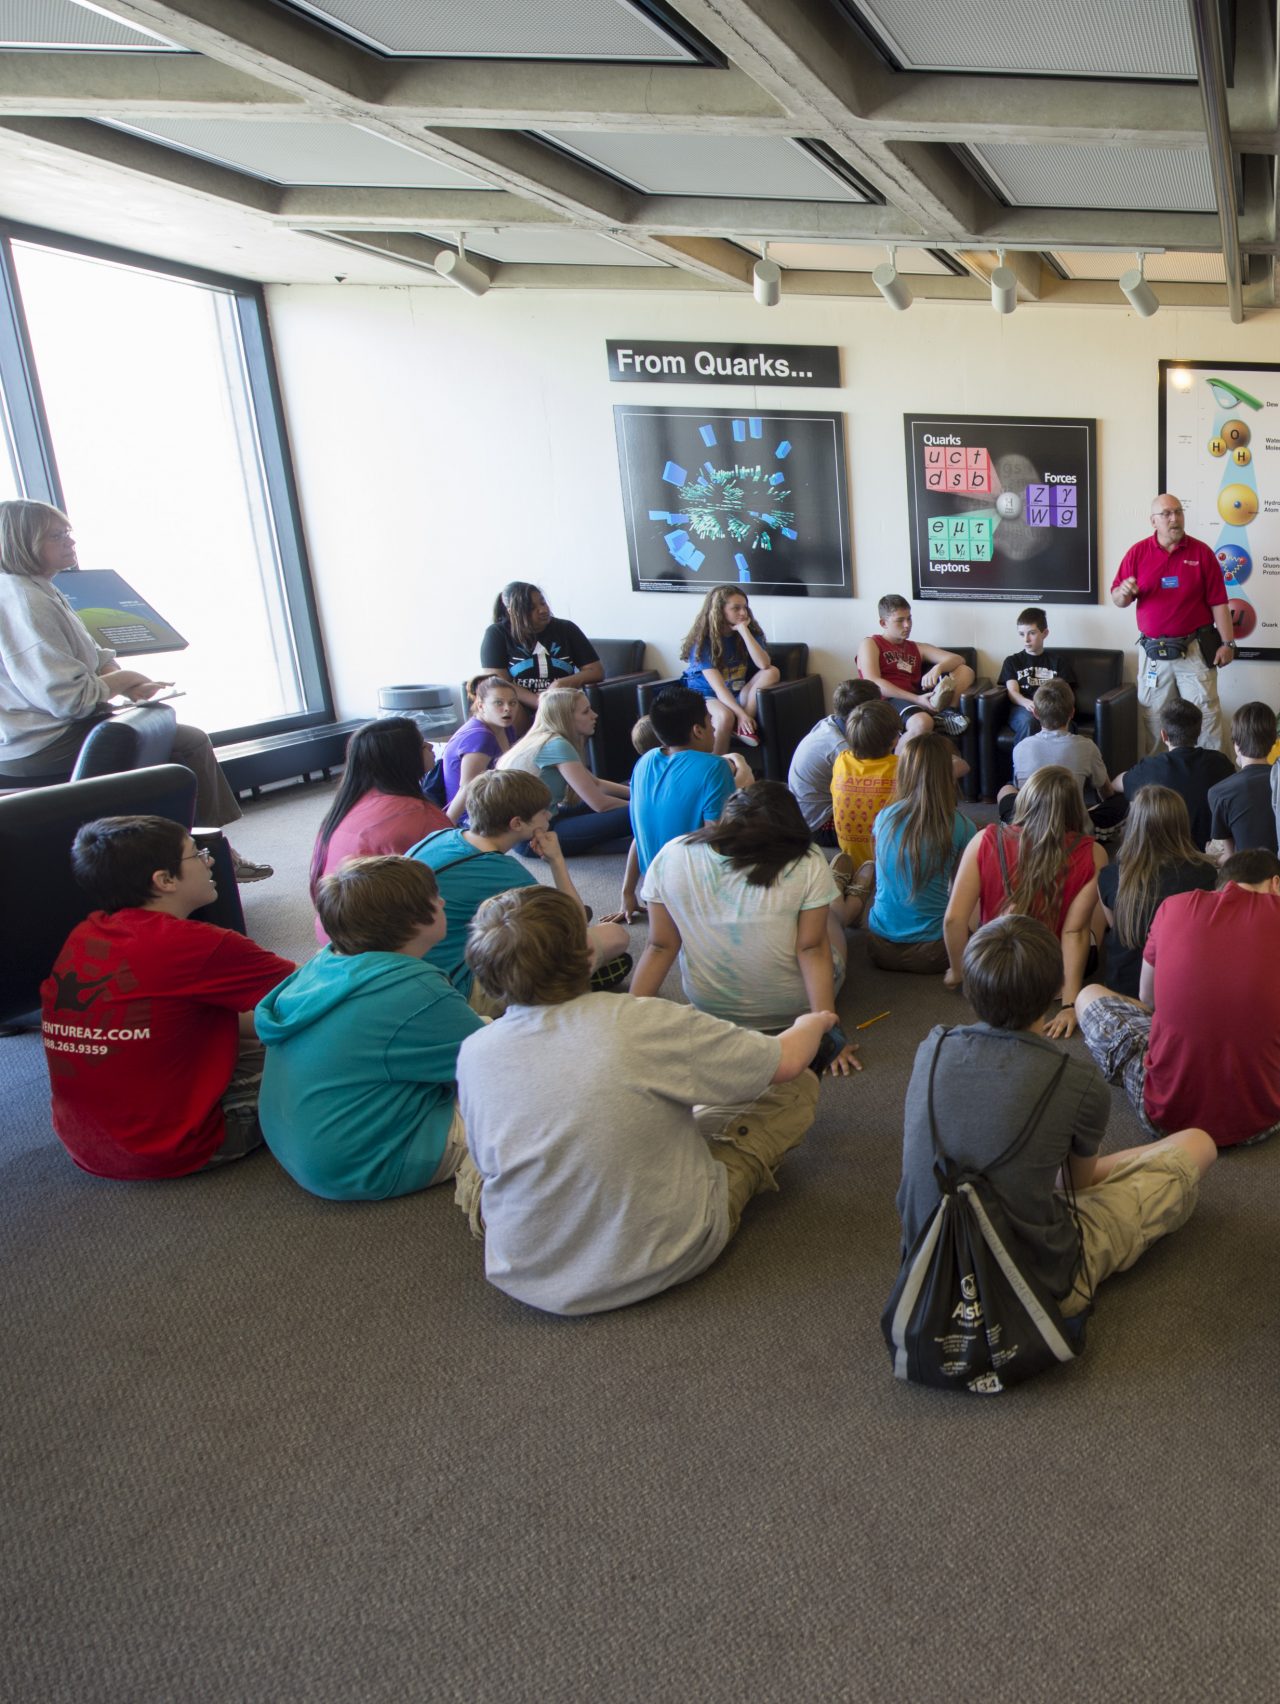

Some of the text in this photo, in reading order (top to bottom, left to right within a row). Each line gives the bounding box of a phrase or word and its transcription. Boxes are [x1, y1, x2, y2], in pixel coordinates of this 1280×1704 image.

[616, 349, 813, 378] From Quarks...
[923, 433, 962, 446] Quarks
[1230, 429, 1240, 440] O
[1212, 442, 1221, 452] H
[929, 450, 981, 465] u c t
[1237, 451, 1246, 462] H
[928, 470, 942, 486] d
[971, 473, 985, 487] b
[1044, 472, 1077, 484] Forces
[1061, 509, 1074, 525] g
[929, 562, 970, 574] Leptons
[515, 678, 550, 688] EEPING
[838, 776, 896, 787] AYOFFS
